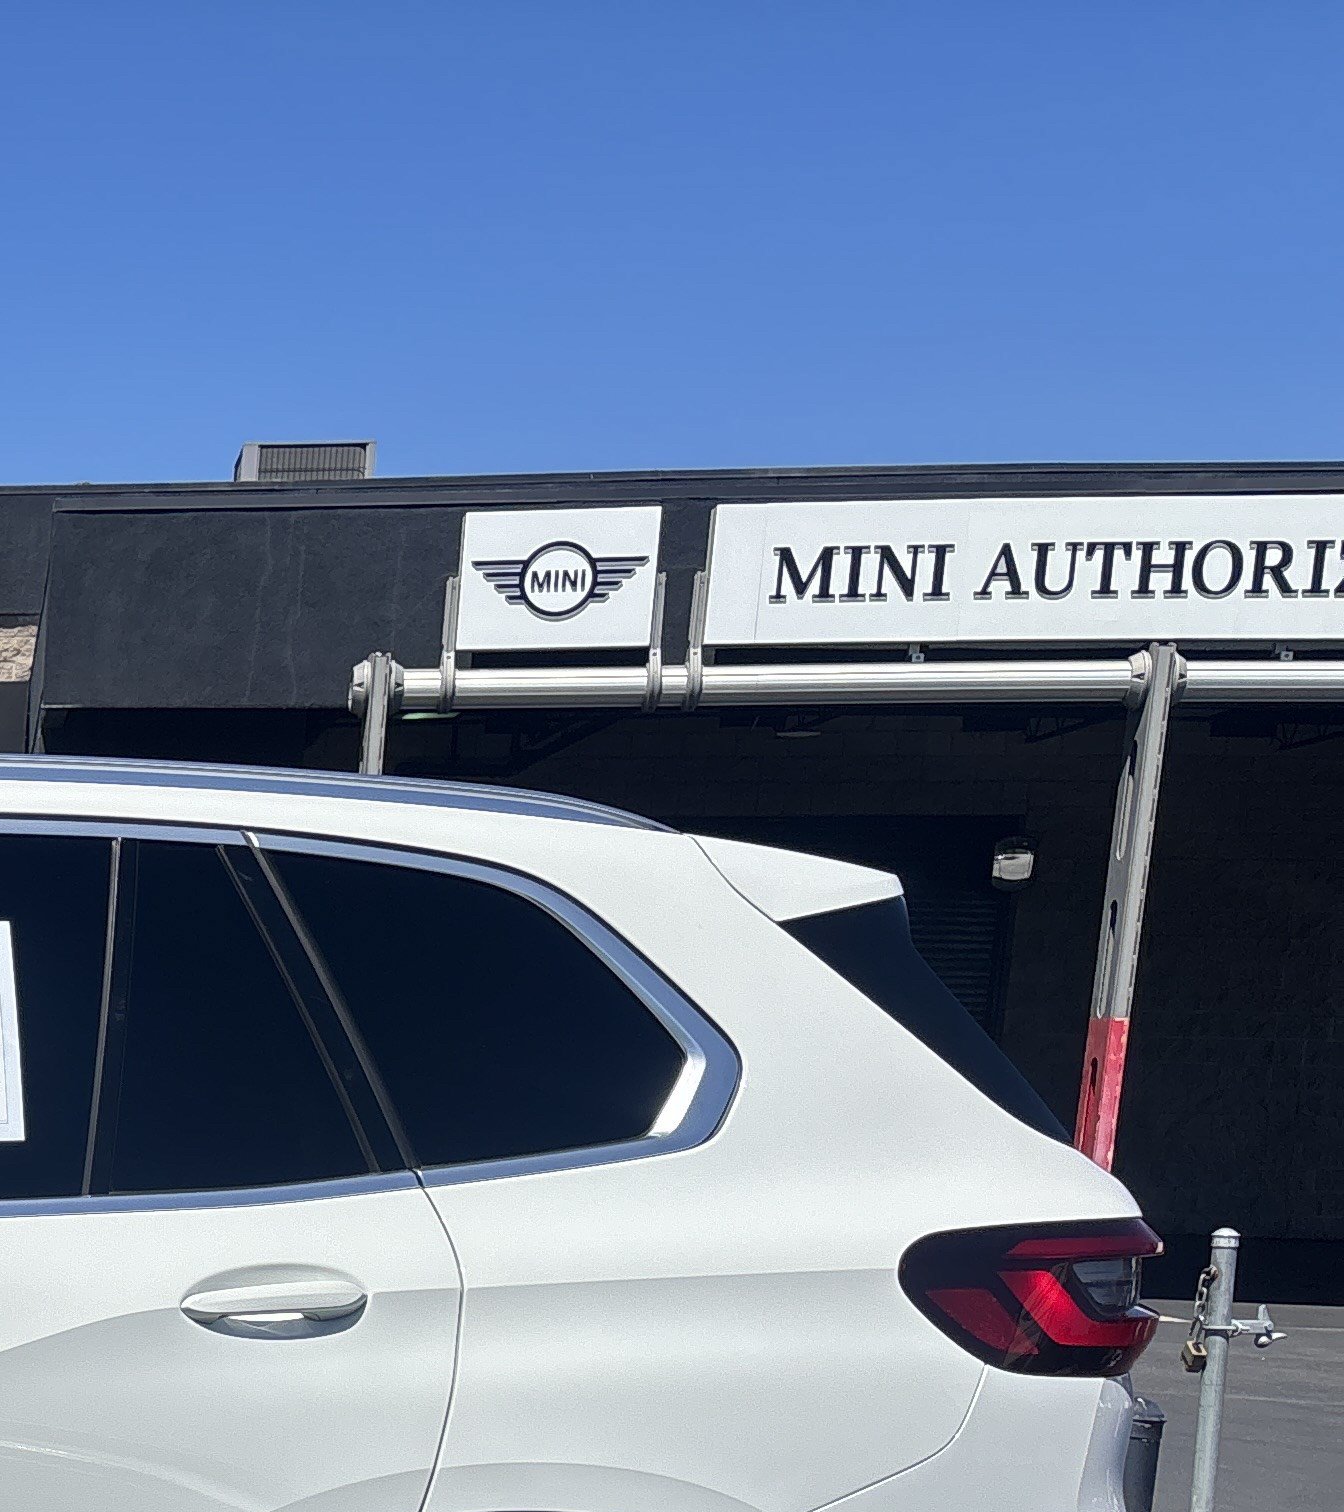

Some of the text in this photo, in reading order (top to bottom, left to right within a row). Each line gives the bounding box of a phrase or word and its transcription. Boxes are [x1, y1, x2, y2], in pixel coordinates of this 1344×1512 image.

[530, 568, 586, 594] MINI
[769, 537, 1344, 604] MINI AUTHORI
